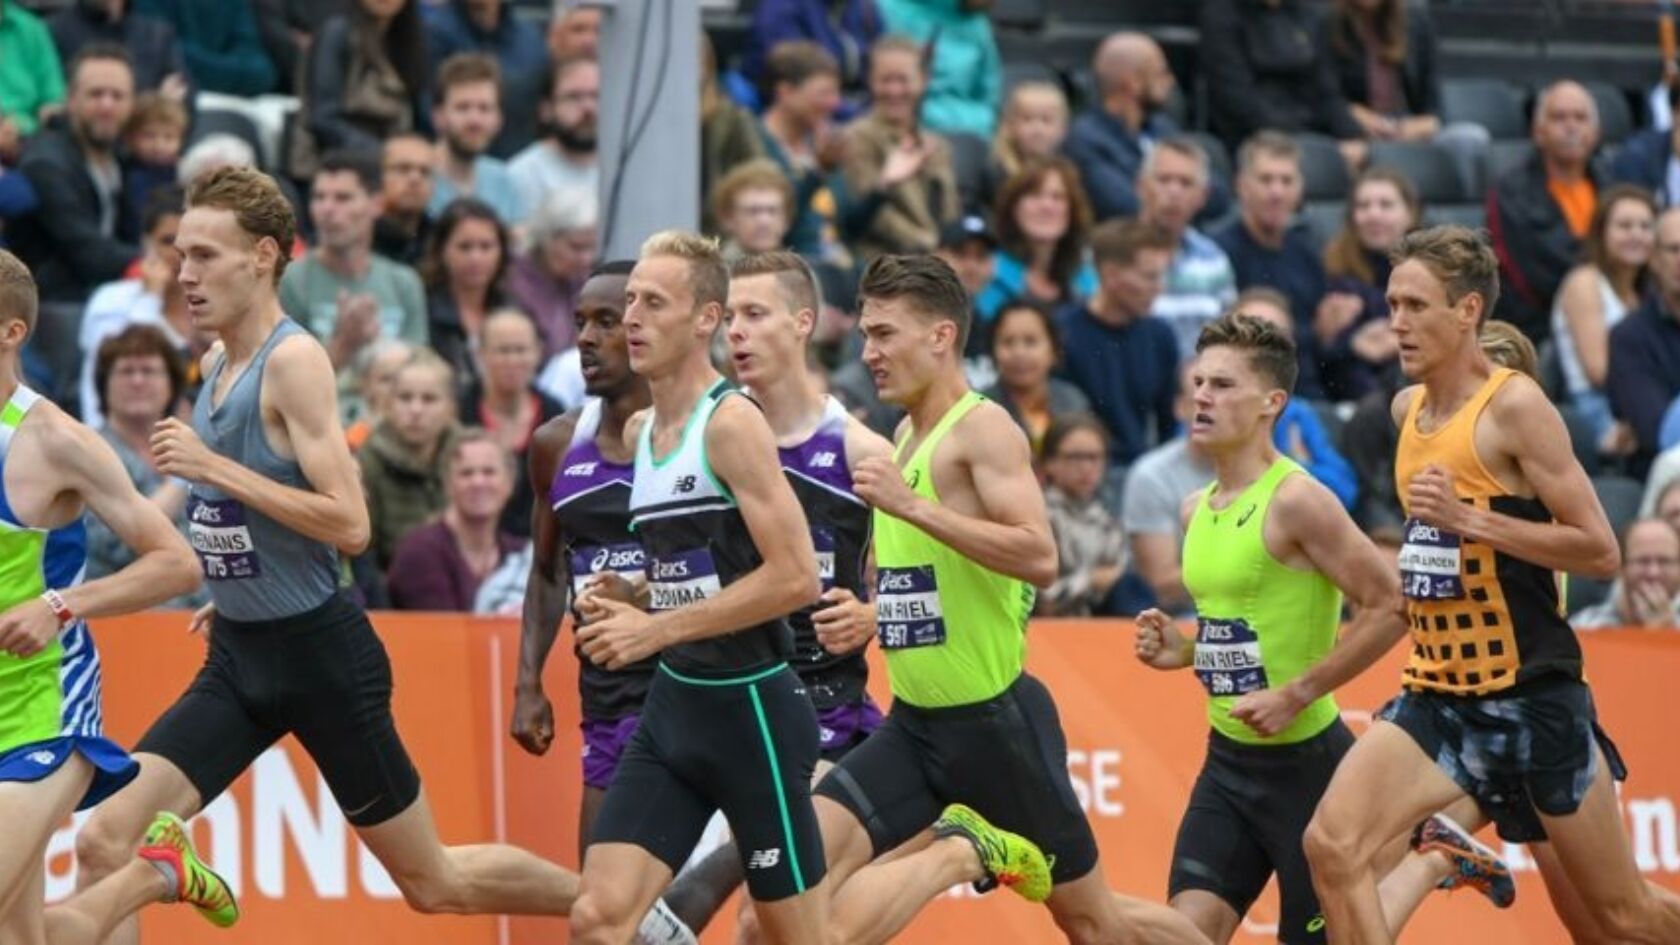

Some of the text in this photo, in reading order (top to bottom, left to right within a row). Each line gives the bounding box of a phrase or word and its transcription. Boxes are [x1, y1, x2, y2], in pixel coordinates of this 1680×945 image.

[896, 601, 934, 617] RIEL
[886, 624, 908, 646] 597
[1217, 648, 1256, 667] RIEL
